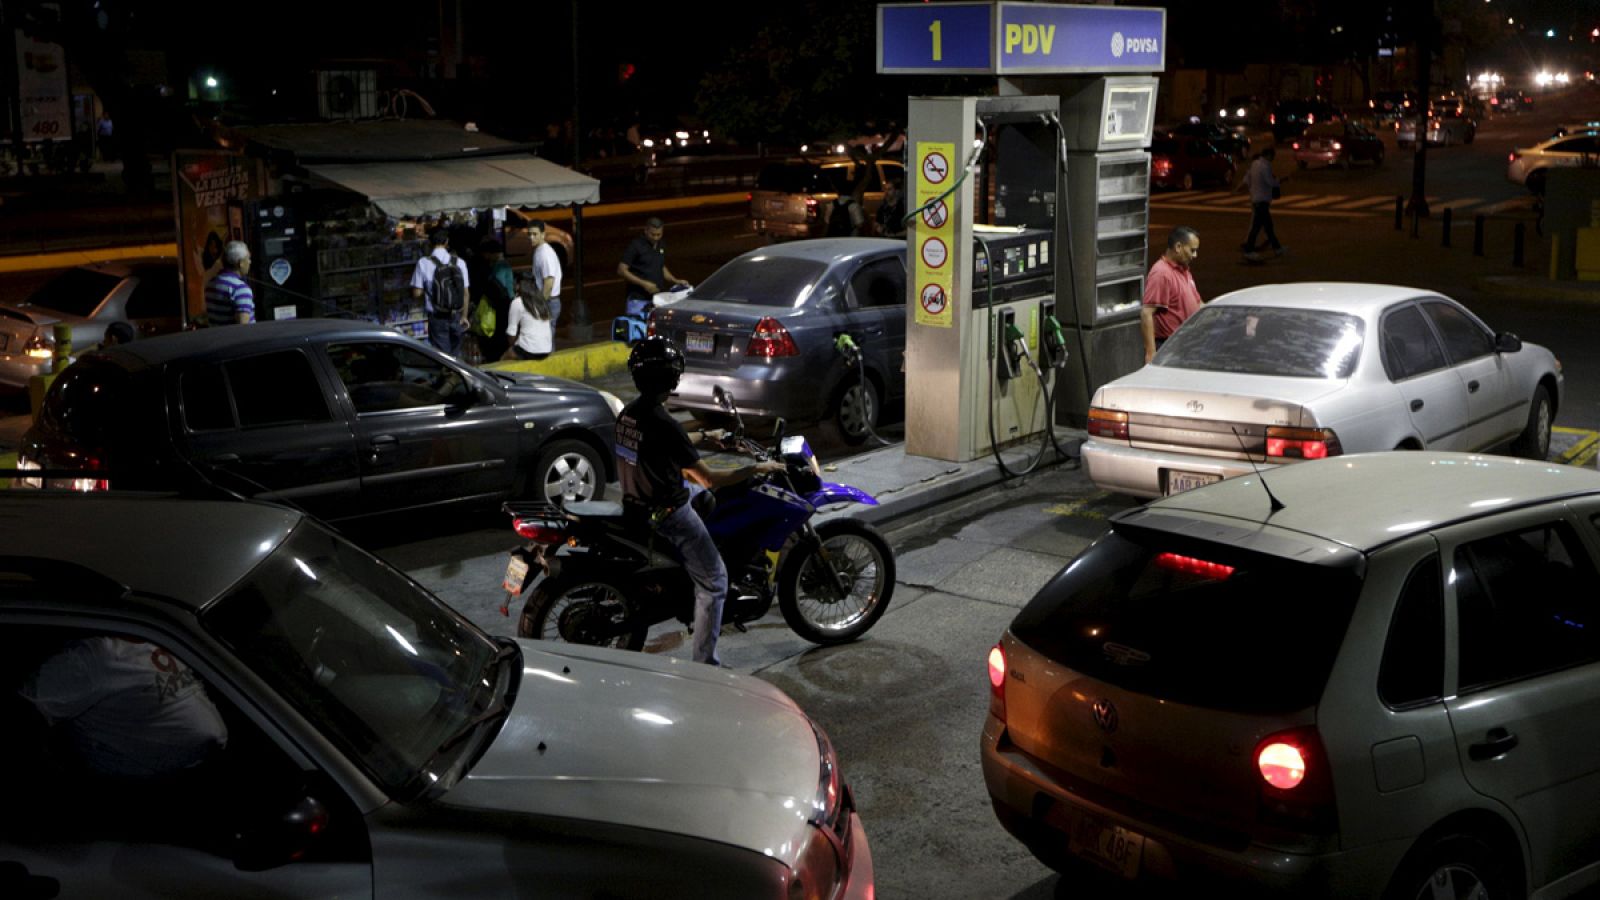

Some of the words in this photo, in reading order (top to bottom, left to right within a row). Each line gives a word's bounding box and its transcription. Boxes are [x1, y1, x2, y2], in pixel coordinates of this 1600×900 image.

[929, 19, 942, 61] 1
[1005, 23, 1056, 55] PDV
[1126, 38, 1158, 53] PDVSA
[33, 120, 59, 134] 480
